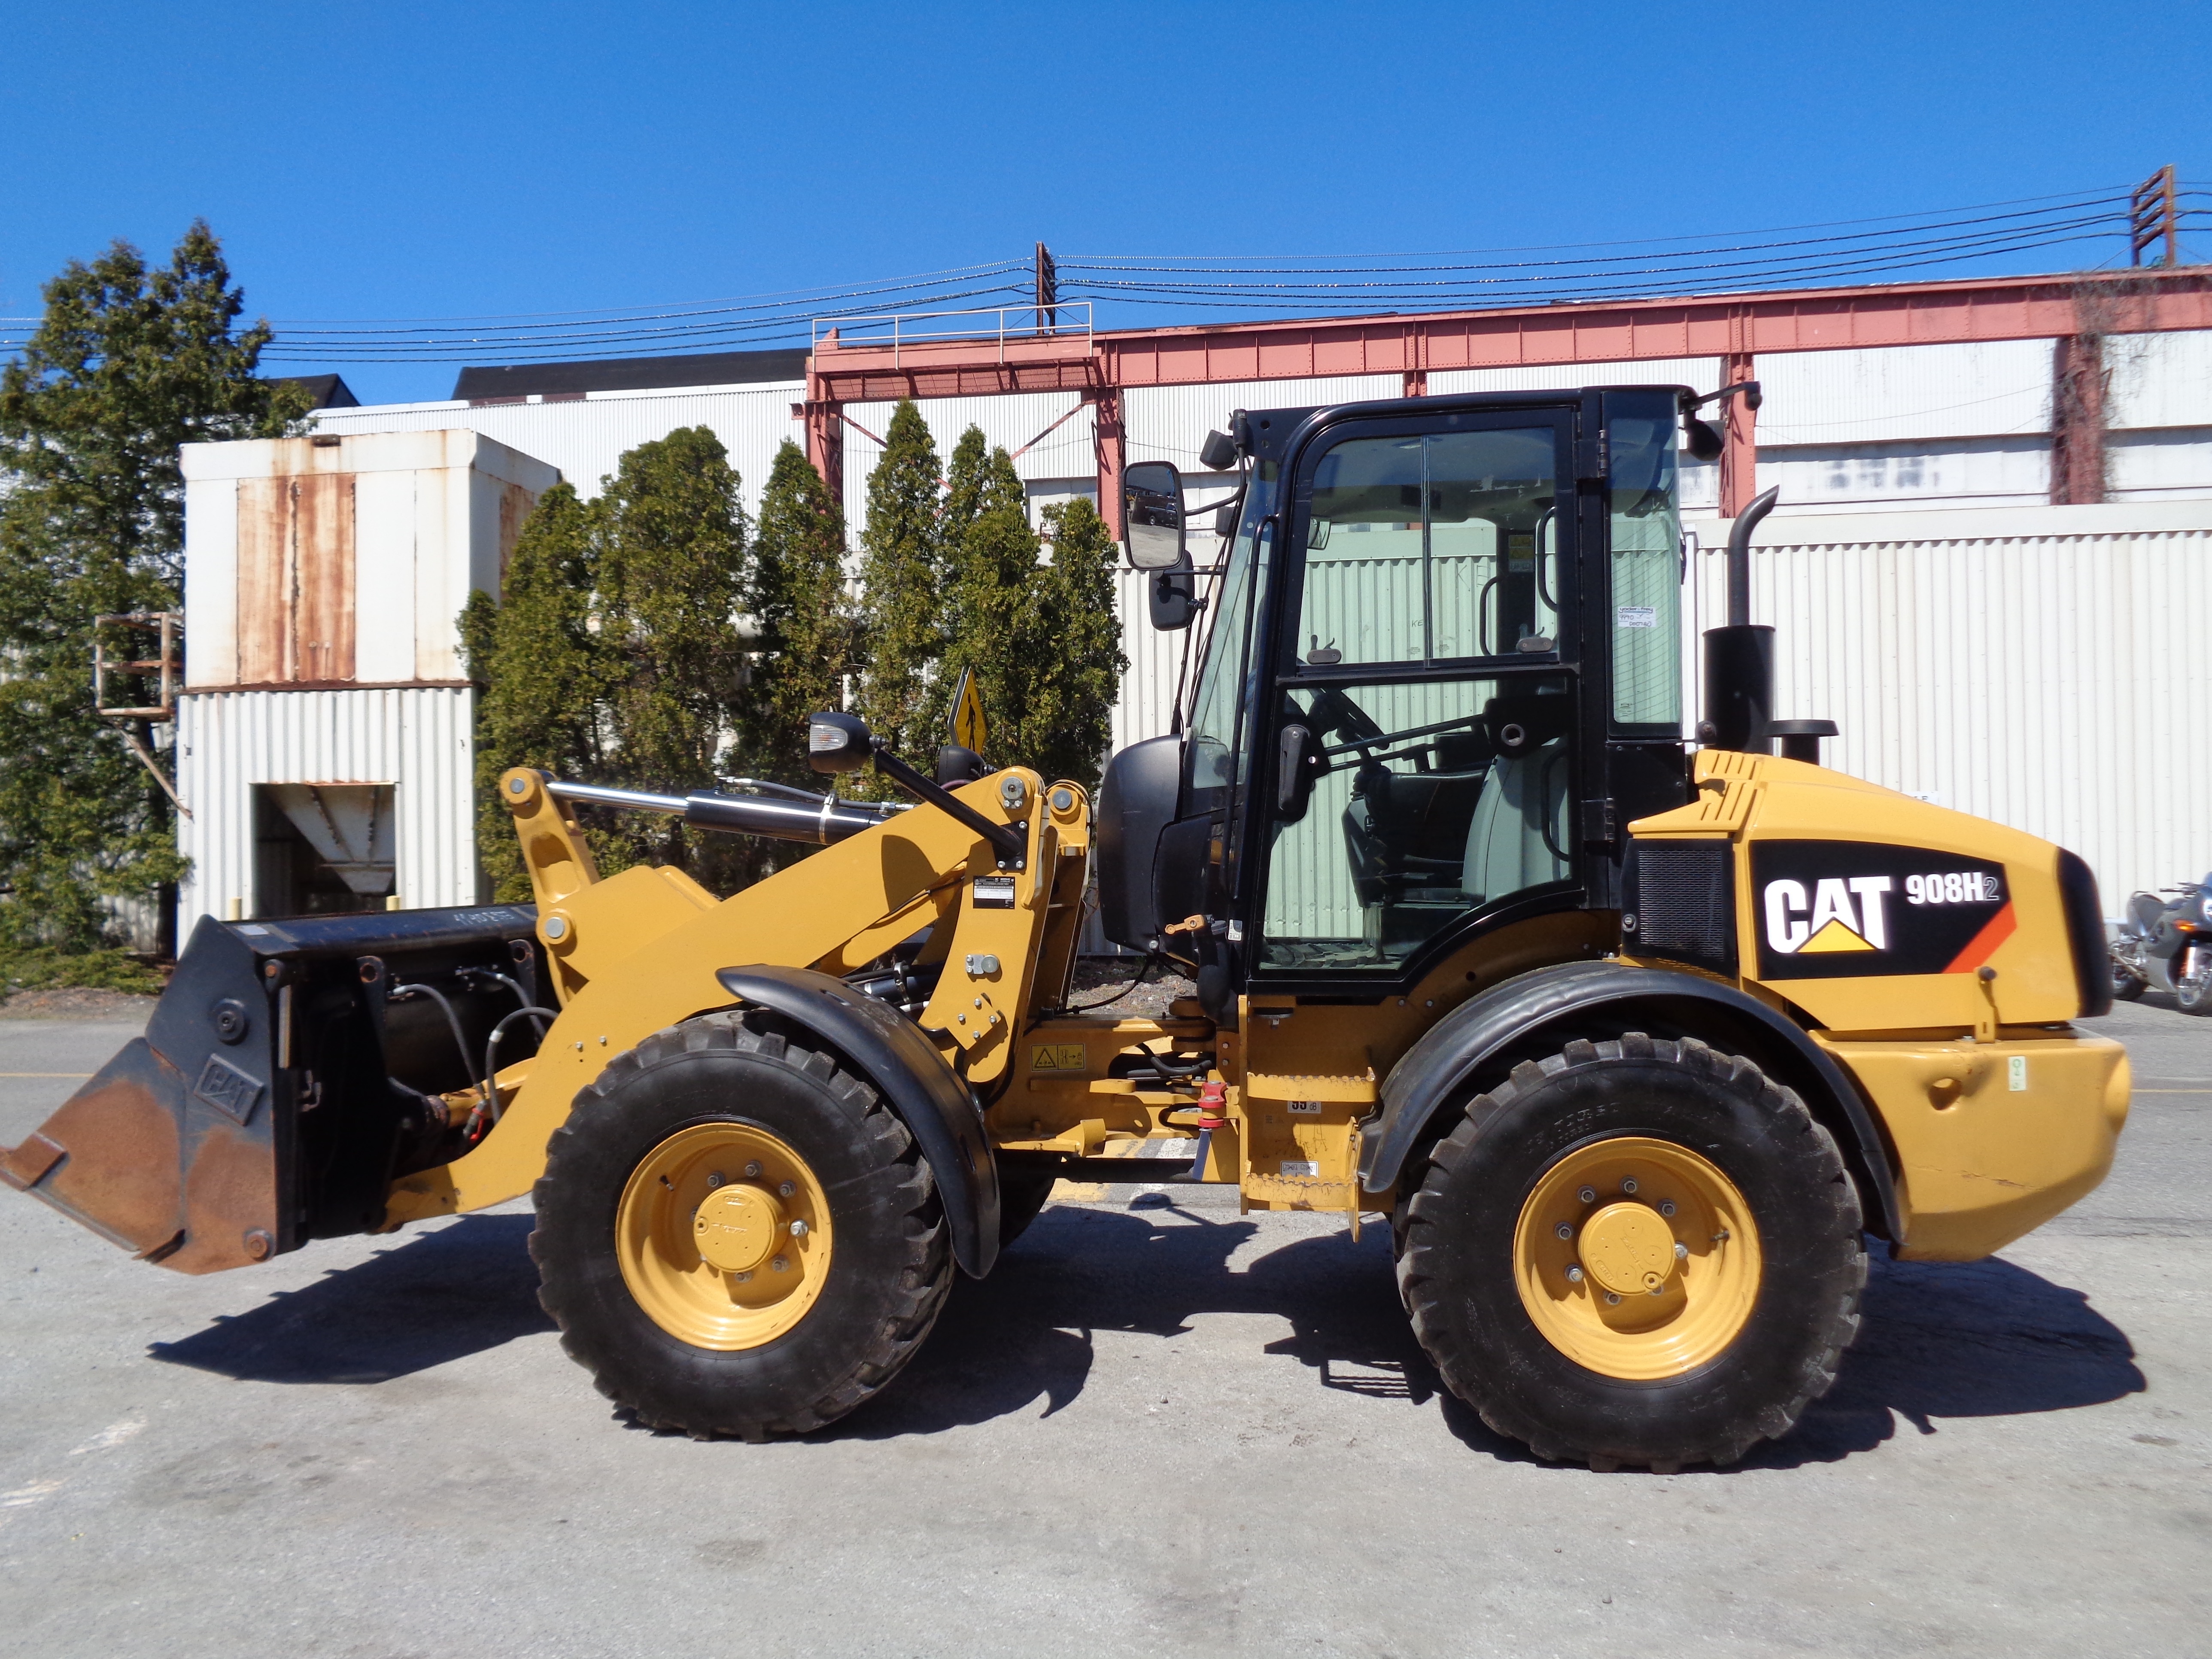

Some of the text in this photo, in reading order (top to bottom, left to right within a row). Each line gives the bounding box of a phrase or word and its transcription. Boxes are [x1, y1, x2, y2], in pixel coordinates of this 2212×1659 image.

[1906, 872, 1999, 904] 908H2
[1764, 876, 1891, 954] CAT
[1310, 1102, 1317, 1110] dB
